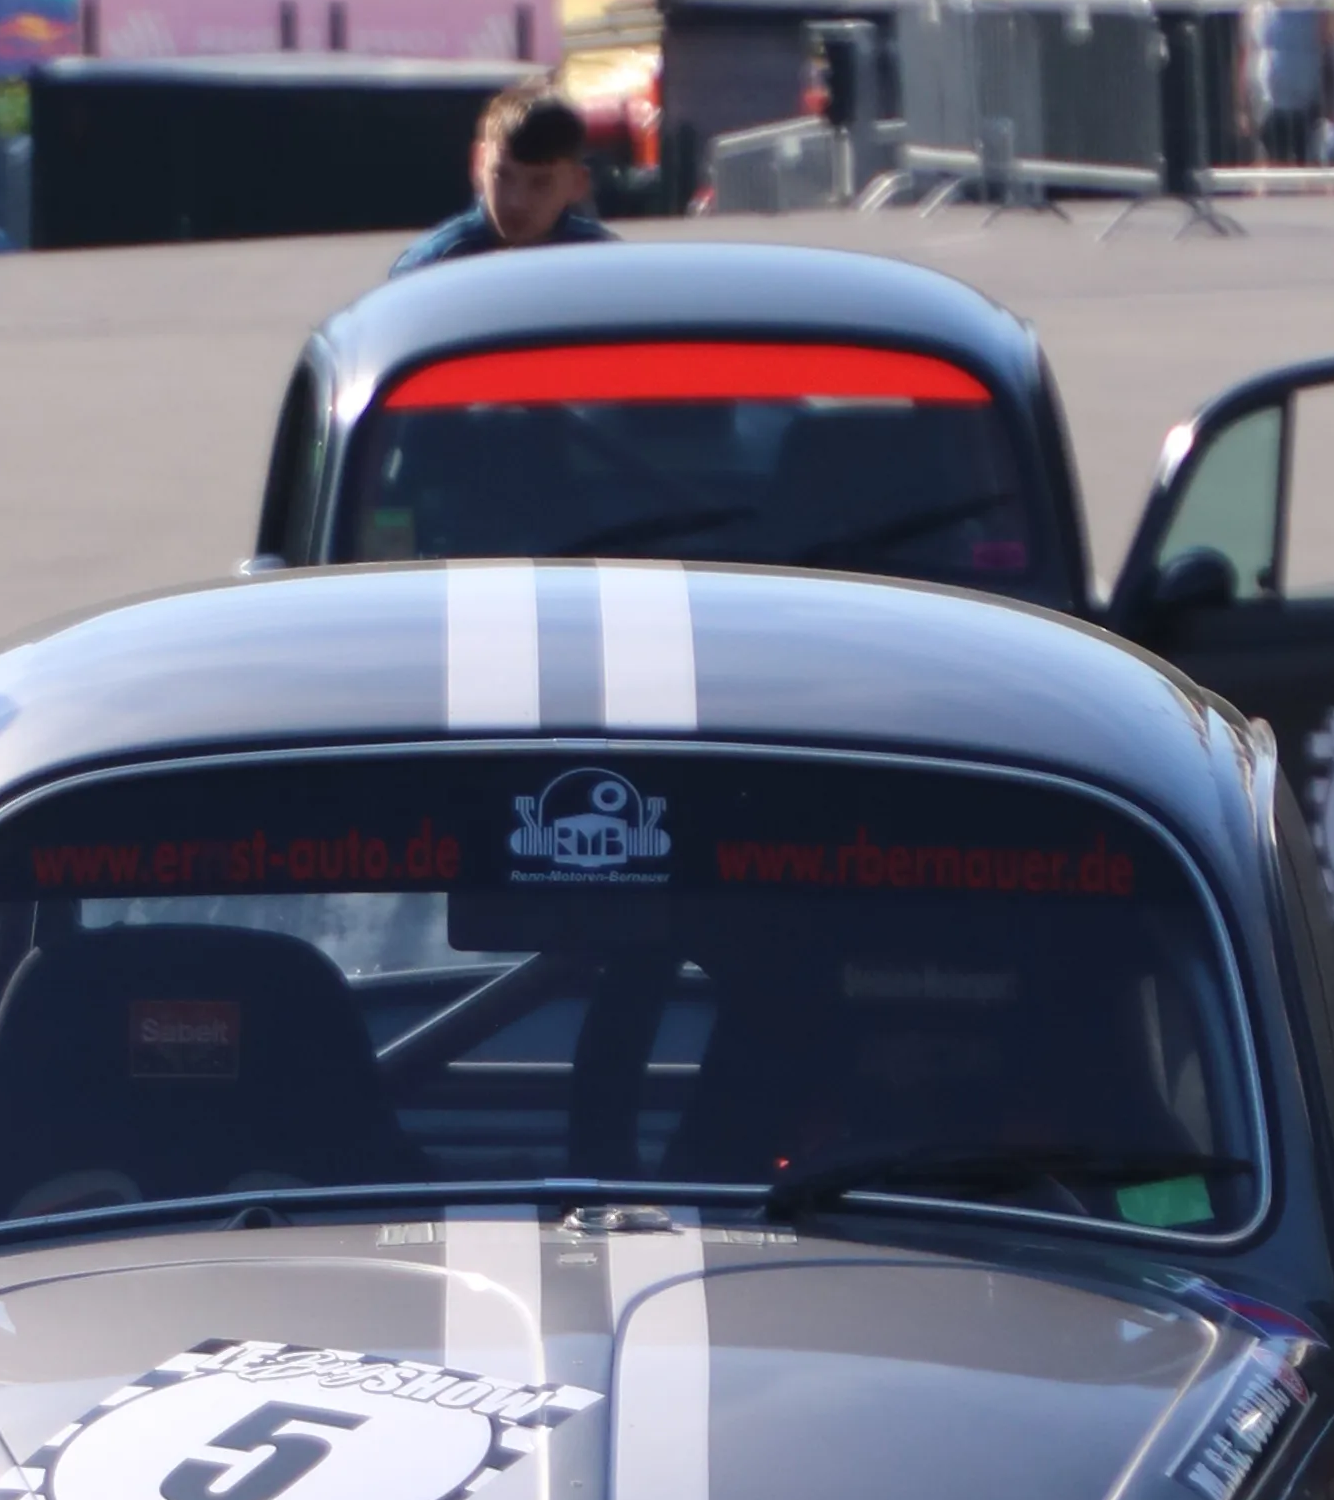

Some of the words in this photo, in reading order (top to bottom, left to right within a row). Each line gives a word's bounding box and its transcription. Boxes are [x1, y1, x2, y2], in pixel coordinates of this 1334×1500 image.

[715, 826, 1135, 896] www.rbernauer.de
[202, 1346, 280, 1376] LE
[366, 1368, 551, 1420] SHOW
